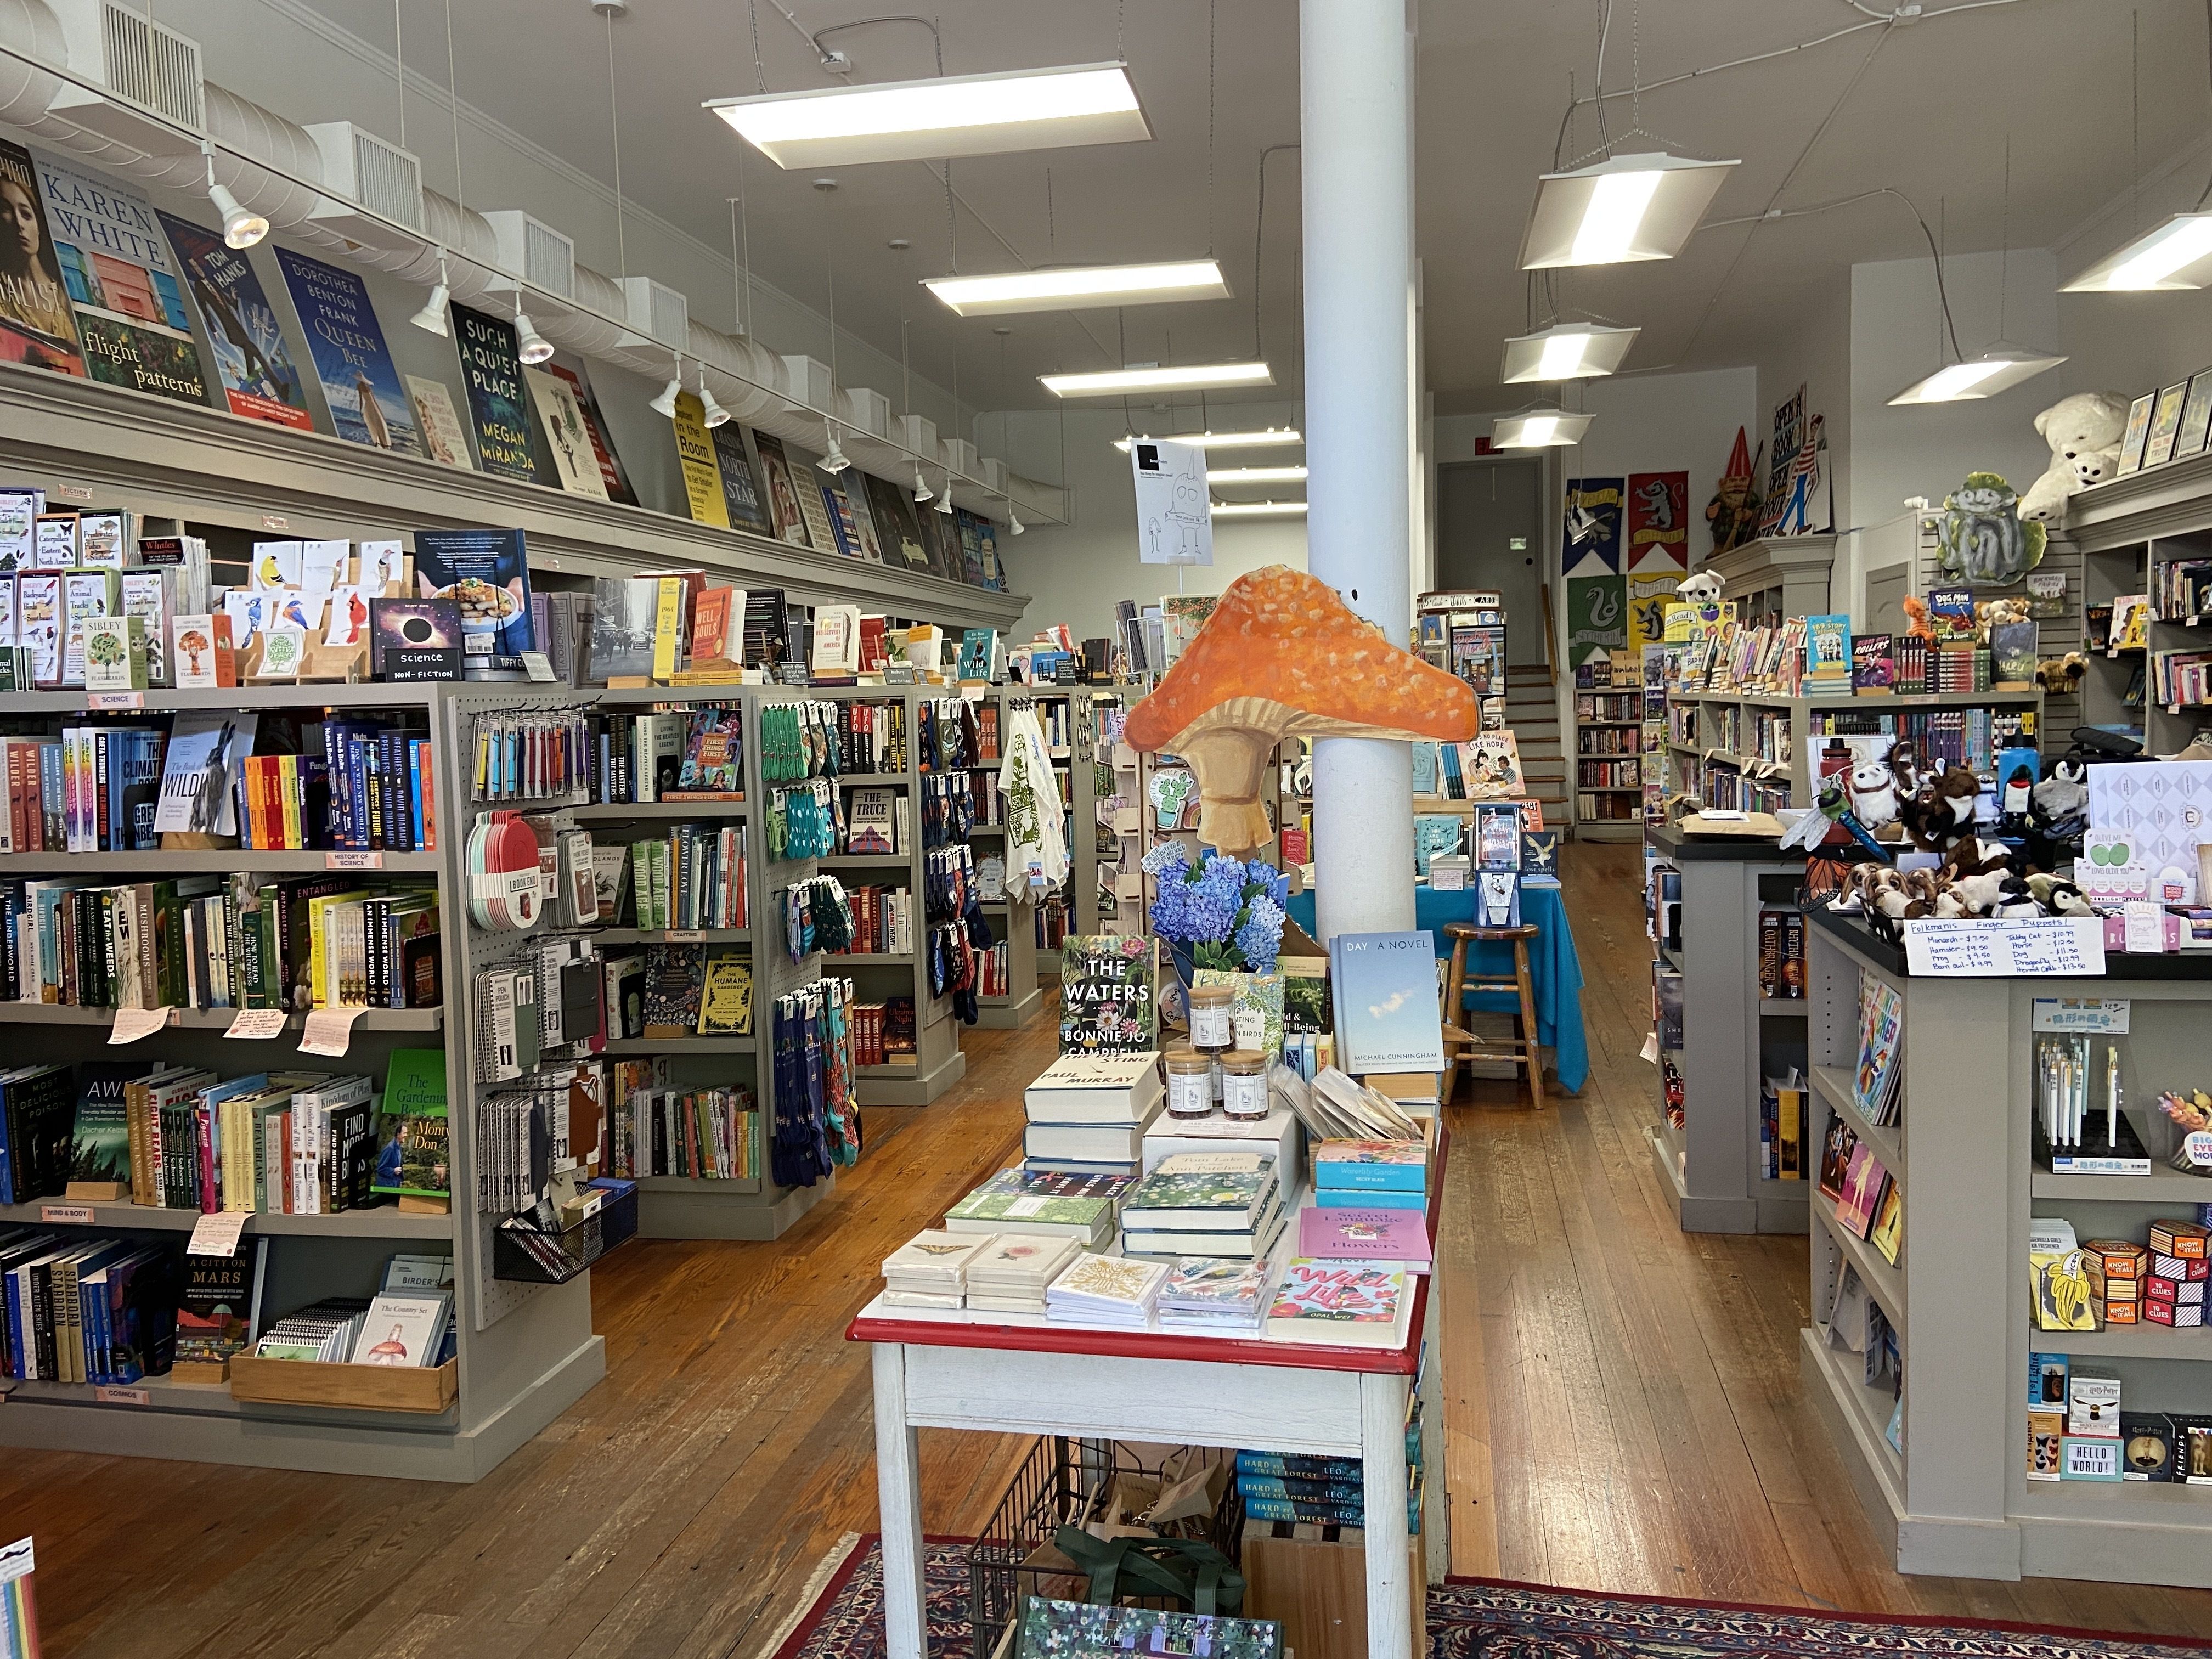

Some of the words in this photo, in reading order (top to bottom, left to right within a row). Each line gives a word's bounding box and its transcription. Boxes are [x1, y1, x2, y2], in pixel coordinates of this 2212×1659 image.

[42, 172, 153, 234] KAREN
[52, 207, 165, 267] WHITE
[205, 250, 229, 269] TOM
[215, 261, 247, 288] HANKS
[291, 262, 358, 296] DOROTHEA
[306, 285, 357, 312] BENTON
[319, 305, 359, 328] FRANK
[314, 318, 377, 352] QUEEN
[466, 319, 507, 348] SUCH
[85, 332, 140, 364] flight
[343, 347, 368, 369] BEE
[462, 347, 472, 362] A
[475, 347, 519, 376] QUIET
[134, 365, 203, 397] patterns
[472, 370, 517, 400] PLACE
[1775, 399, 1794, 430] OPEN
[482, 421, 526, 447] MEGAN
[676, 419, 685, 432] in
[687, 422, 701, 438] the
[680, 436, 709, 459] Room
[1773, 430, 1794, 460] BOOK
[481, 444, 536, 471] MIRANDA
[720, 455, 751, 481] NORTH
[726, 481, 758, 507] STAR
[145, 540, 176, 550] Whales
[70, 589, 92, 597] Animal
[1936, 594, 1952, 602] DOG
[1953, 594, 1969, 602] MAN
[88, 621, 121, 631] SIBLEY
[697, 610, 714, 624] WELL
[1672, 612, 1692, 623] Read!
[695, 623, 717, 638] SOULS
[555, 617, 565, 666] MONOPOLY
[1855, 640, 1889, 654] ROLLERS
[964, 660, 984, 669] Wild
[969, 669, 987, 678] Life
[1999, 660, 2025, 672] HARU
[1469, 741, 1484, 751] LIKE
[1486, 741, 1505, 749] HOPE
[10, 751, 20, 786] WILDER
[864, 792, 881, 800] THE
[856, 803, 886, 812] TRUCE
[297, 881, 349, 898] ENTANGLED
[512, 878, 527, 890] BOOK
[527, 876, 535, 887] END
[366, 904, 372, 915] AN
[1911, 923, 1957, 933] Folkmanis
[1977, 921, 2006, 933] Finger
[2022, 918, 2068, 928] Puppets!
[140, 904, 150, 967] MUSHROOMS
[2006, 934, 2027, 943] Tabby
[6, 916, 14, 981] UNDERWORLD
[1347, 943, 1368, 951] DAY
[1378, 941, 1385, 950] A
[1389, 940, 1428, 949] NOVEL
[105, 943, 115, 978] WEEDS
[1764, 929, 1776, 982] OATHBRINGER
[1087, 960, 1126, 977] THE
[1064, 984, 1149, 1001] WATERS
[1064, 1030, 1122, 1042] BONNIE
[1126, 1031, 1146, 1042] JO
[32, 1078, 58, 1091] MOST
[408, 1074, 428, 1088] The
[20, 1086, 72, 1109] DELICIOUS
[321, 1092, 349, 1109] Kingdom
[351, 1088, 357, 1097] of
[357, 1085, 370, 1097] Play
[29, 1101, 65, 1119] POISON
[149, 1094, 159, 1130] EIGHT
[345, 1113, 364, 1131] FIND
[416, 1121, 449, 1138] Monty
[150, 1132, 161, 1169] BEARS
[415, 1136, 437, 1150] Don
[255, 1123, 263, 1184] BEAVERLAND
[1104, 1182, 1125, 1195] BLACK
[201, 1259, 227, 1267] CITY
[193, 1271, 240, 1283] MARS
[402, 1277, 440, 1286] BIRDER'S
[1291, 1266, 1391, 1288] Wild
[52, 1270, 66, 1327] STARBORN
[1293, 1285, 1368, 1306] Life
[2076, 1447, 2107, 1459] HELLO
[2073, 1460, 2108, 1473] WORLD!
